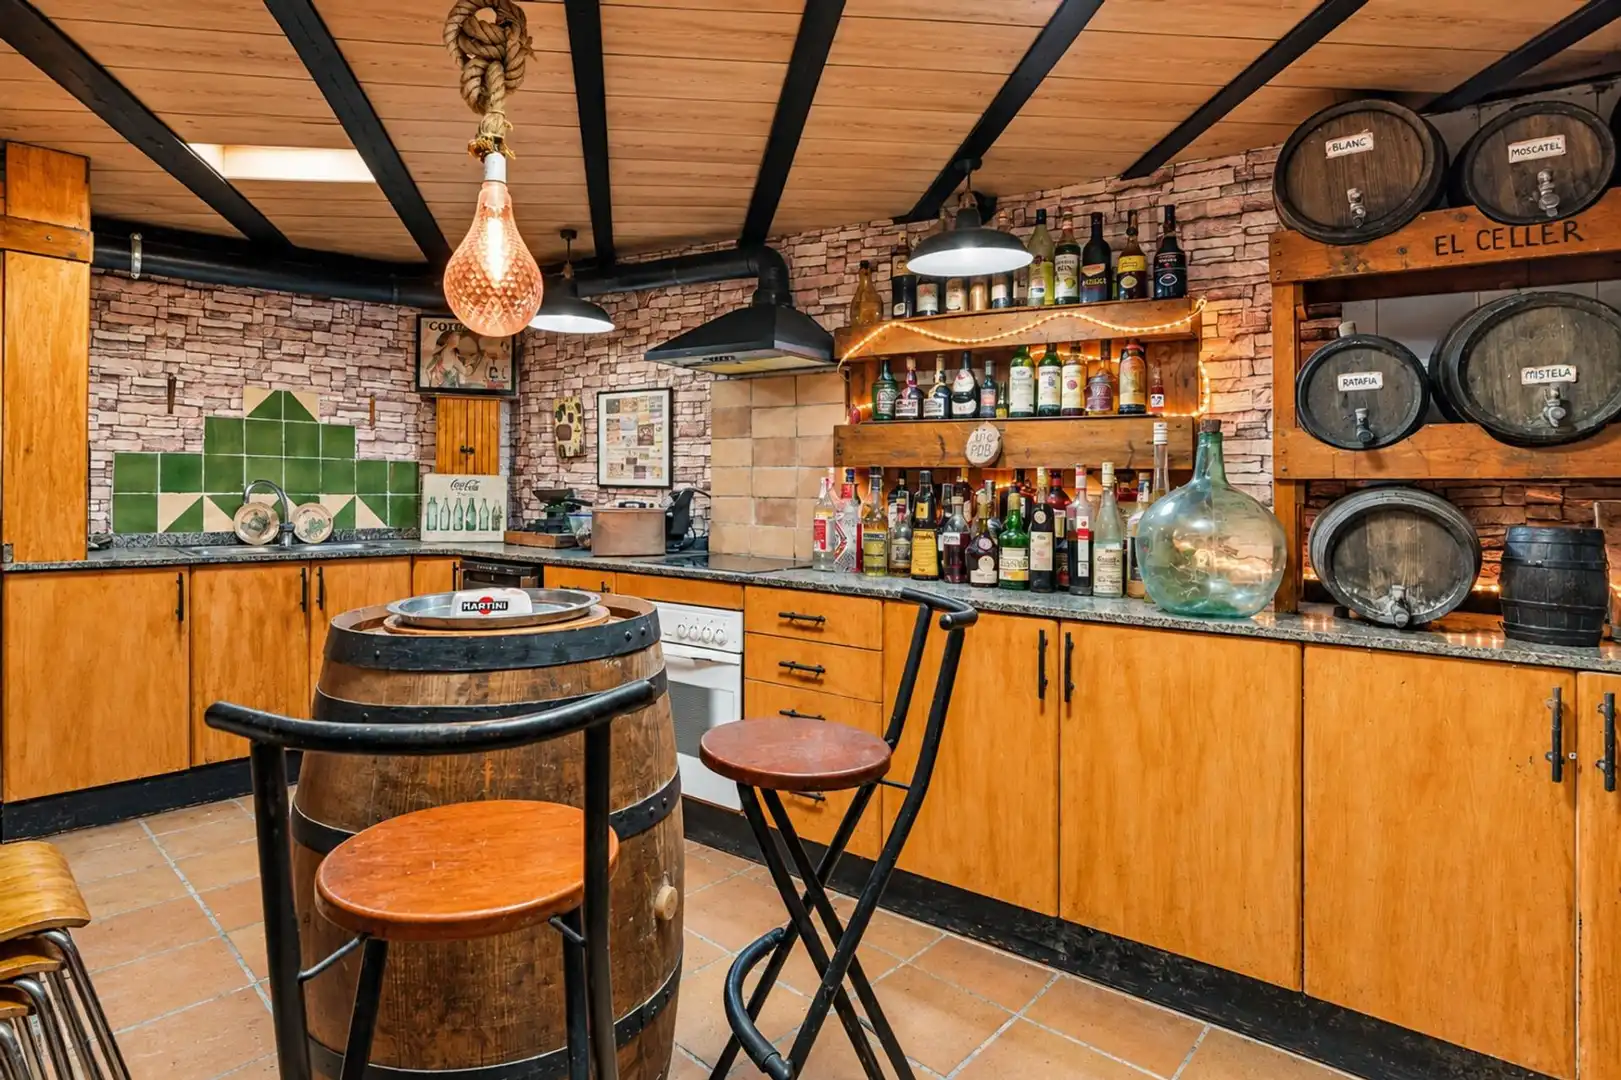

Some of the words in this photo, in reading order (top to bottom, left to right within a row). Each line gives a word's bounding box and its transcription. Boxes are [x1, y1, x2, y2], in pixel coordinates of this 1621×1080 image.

[1332, 137, 1367, 152] BLANC
[1510, 142, 1562, 156] MOSCATEL
[1434, 234, 1464, 256] EL
[1476, 220, 1584, 251] CELLER
[1525, 367, 1572, 380] MISTELA
[1342, 376, 1378, 387] RATAFIA
[463, 602, 506, 610] MARTINI
